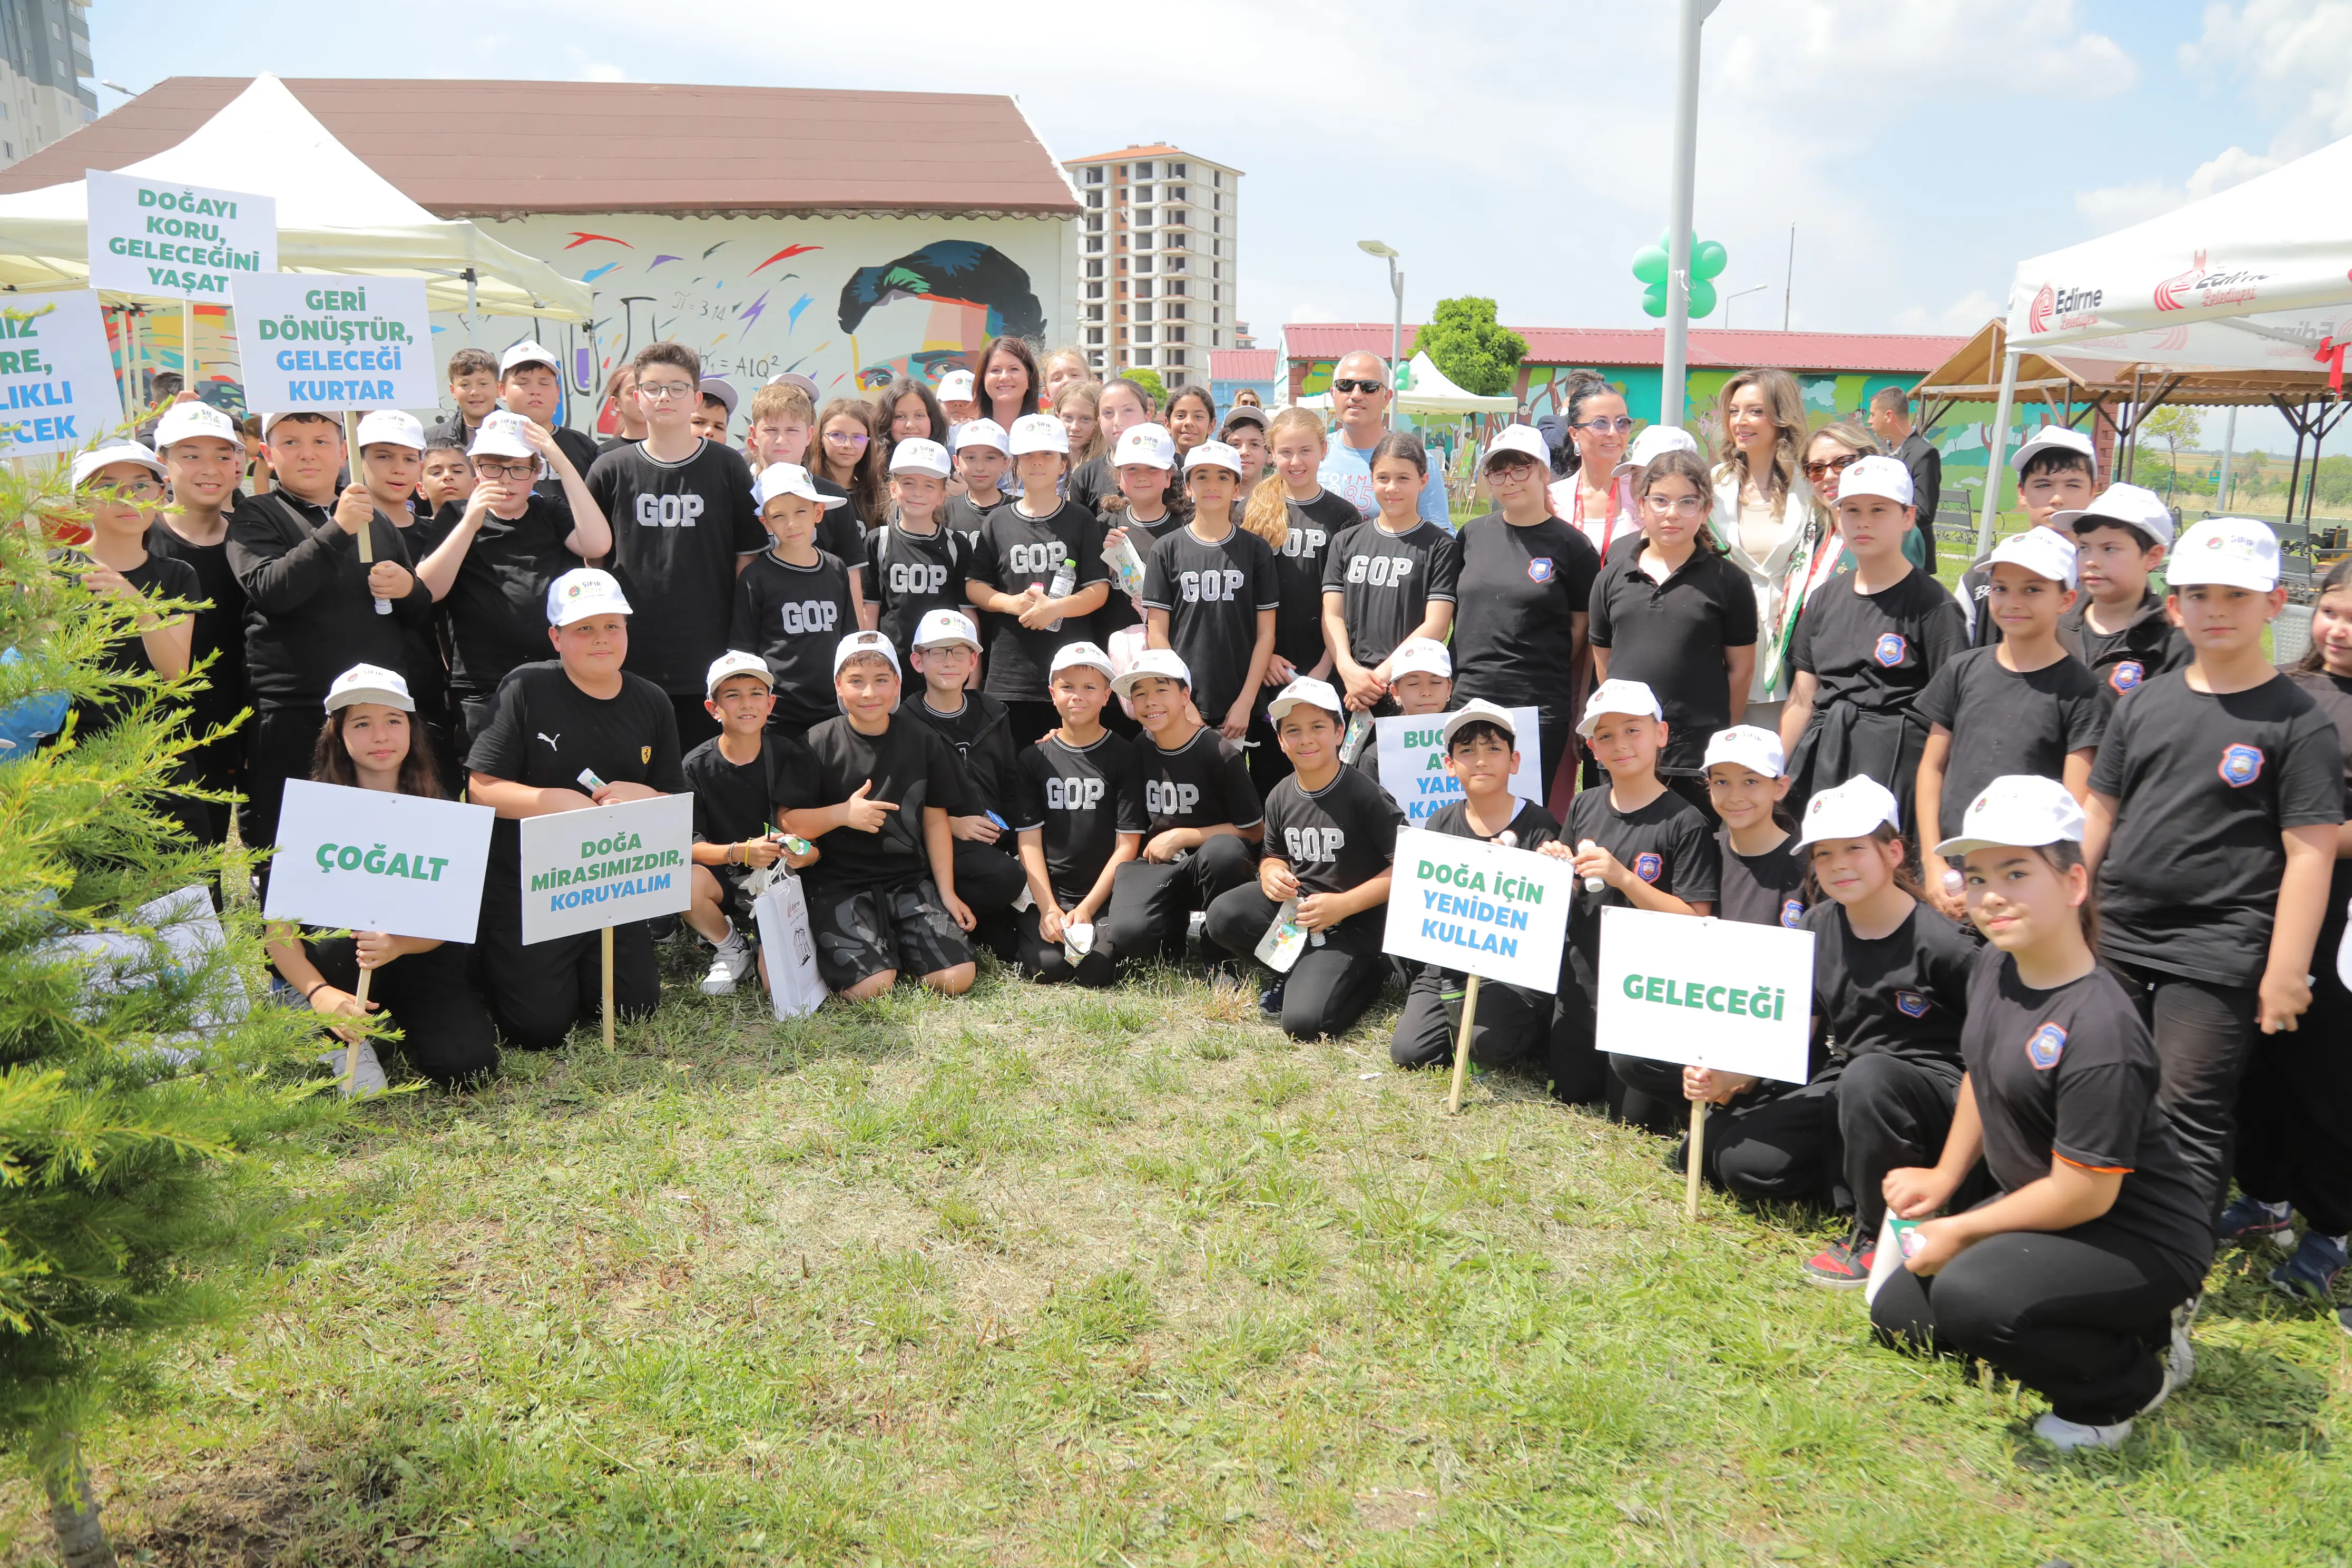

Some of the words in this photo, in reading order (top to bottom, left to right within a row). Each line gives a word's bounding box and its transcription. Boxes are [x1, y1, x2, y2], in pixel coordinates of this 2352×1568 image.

[139, 189, 237, 219] DOĞAYI
[146, 216, 227, 247] KORU,
[109, 237, 260, 272] GELECEĞİNİ
[148, 267, 229, 294] YAŞAT
[2202, 285, 2257, 307] Belediyesi
[306, 287, 366, 312] GERİ
[2056, 287, 2102, 315] Edirne
[259, 315, 414, 346] DÖNÜŞTÜR,
[2061, 311, 2099, 330] Belediyesi
[277, 346, 403, 371] GELECEĞİ
[289, 379, 395, 401] KURTAR
[636, 493, 704, 527] GOP
[1010, 541, 1067, 574] GOP
[1273, 528, 1327, 557] OP
[889, 563, 947, 594] GOP
[1180, 569, 1244, 602] GOP
[1347, 555, 1414, 587] GOP
[781, 600, 838, 633] GOP
[953, 617, 966, 626] SIFIR
[1046, 777, 1105, 810] GOP
[1146, 780, 1200, 814] GOP
[581, 831, 642, 859] DOĞA
[1285, 827, 1345, 863] GOP
[316, 844, 449, 882] ÇOĞALT
[531, 849, 684, 892] MİRASIMIZDIR,
[550, 873, 671, 912] KORUYALIM
[1417, 860, 1486, 892] DOĞA
[1494, 871, 1544, 905] İÇİN
[1423, 889, 1528, 931] YENİDEN
[1421, 918, 1518, 958] KULLAN
[1623, 974, 1786, 1021] GELECEĞİ
